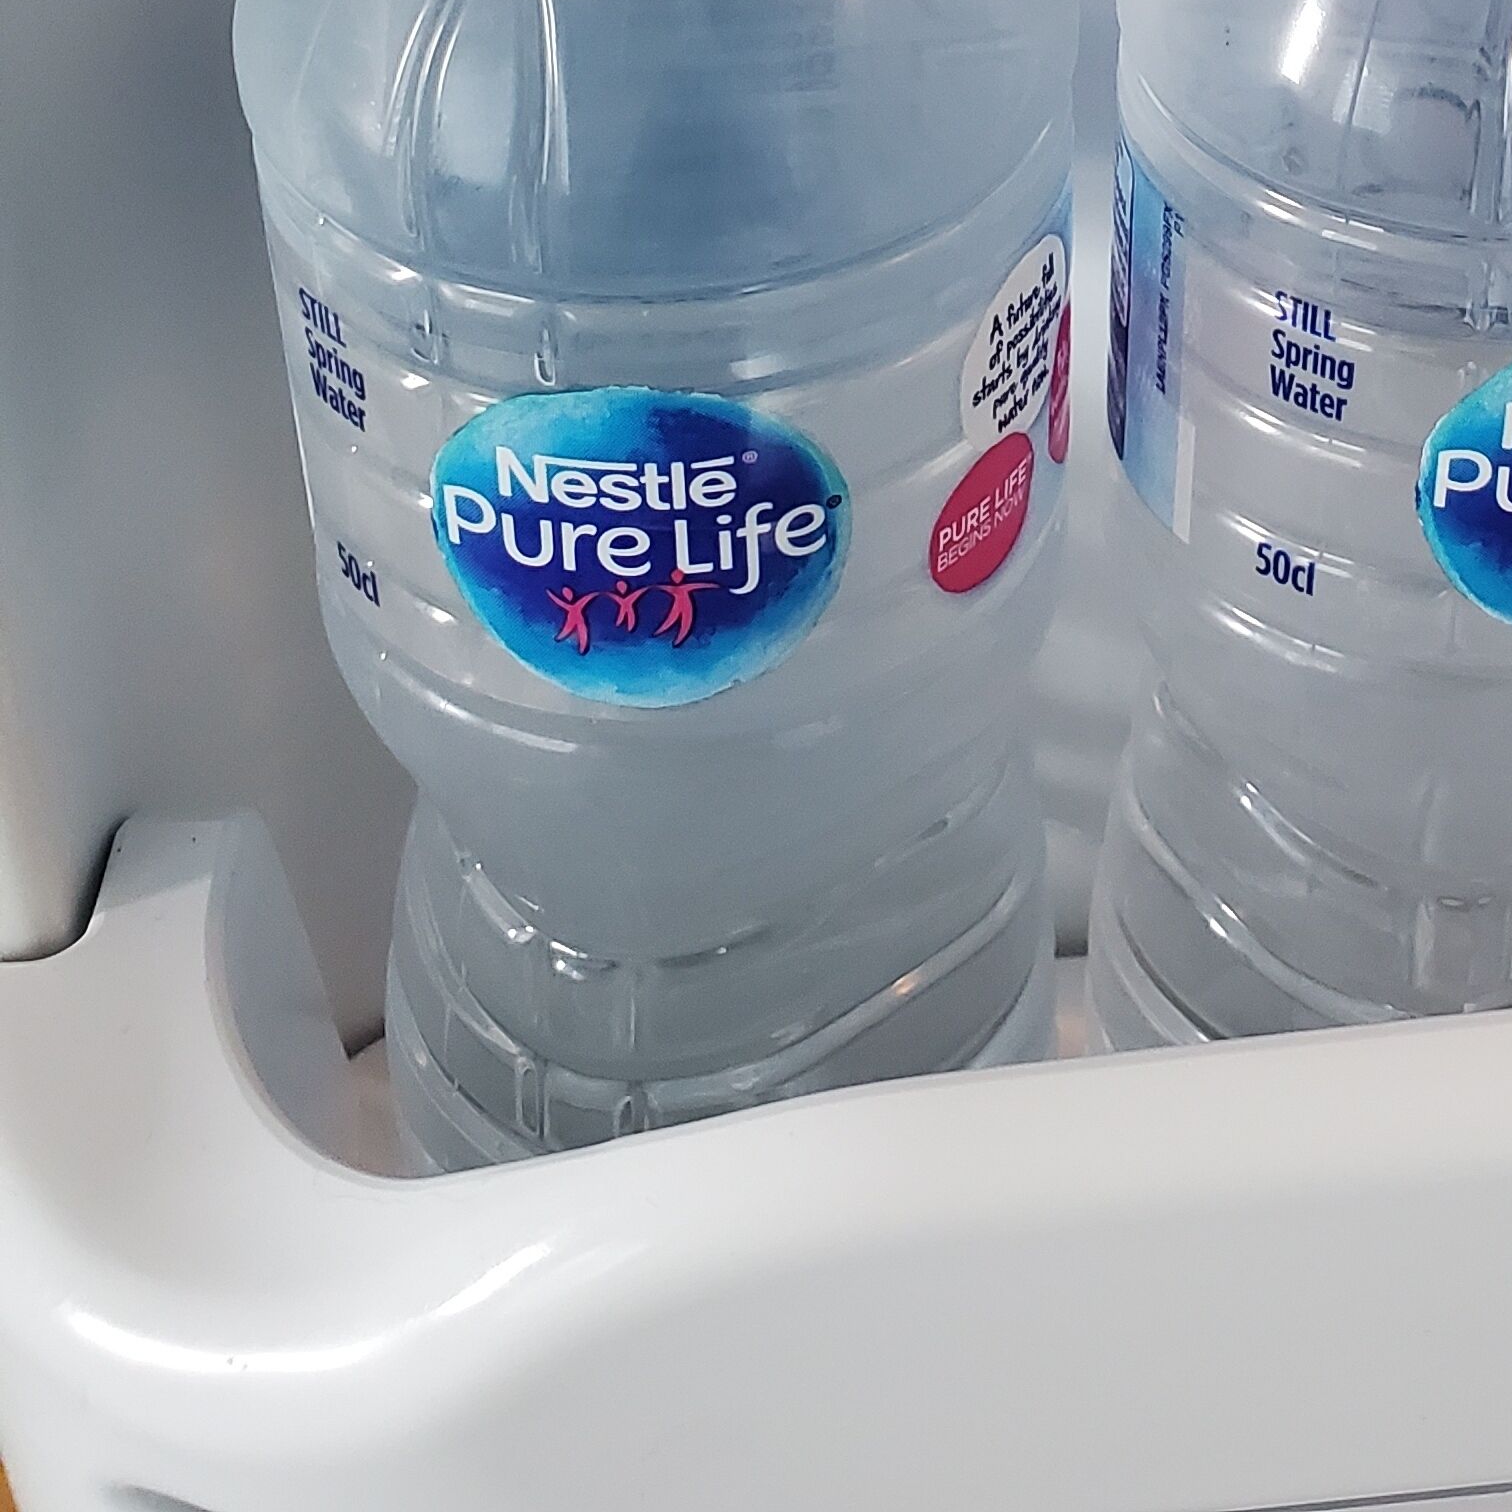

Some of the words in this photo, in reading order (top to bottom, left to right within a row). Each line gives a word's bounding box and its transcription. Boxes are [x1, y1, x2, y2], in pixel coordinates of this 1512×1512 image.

[298, 287, 347, 348] STILL
[989, 313, 1004, 345] A
[1006, 285, 1041, 330] future
[1274, 289, 1337, 343] STILL
[304, 326, 367, 402] Spring
[972, 361, 1013, 408] starts
[1016, 344, 1030, 370] by
[988, 340, 1004, 371] of
[1270, 328, 1356, 390] Spring
[309, 362, 367, 433] Water
[998, 388, 1030, 434] water
[1269, 363, 1348, 422] Water
[936, 518, 992, 573] BEGINS
[993, 486, 1026, 529] NOW
[938, 495, 992, 553] PURE
[993, 457, 1028, 510] LIFE
[442, 483, 652, 578] Pure
[674, 500, 828, 596] Life
[1254, 541, 1316, 597] 50cl
[336, 540, 381, 608] 50cl
